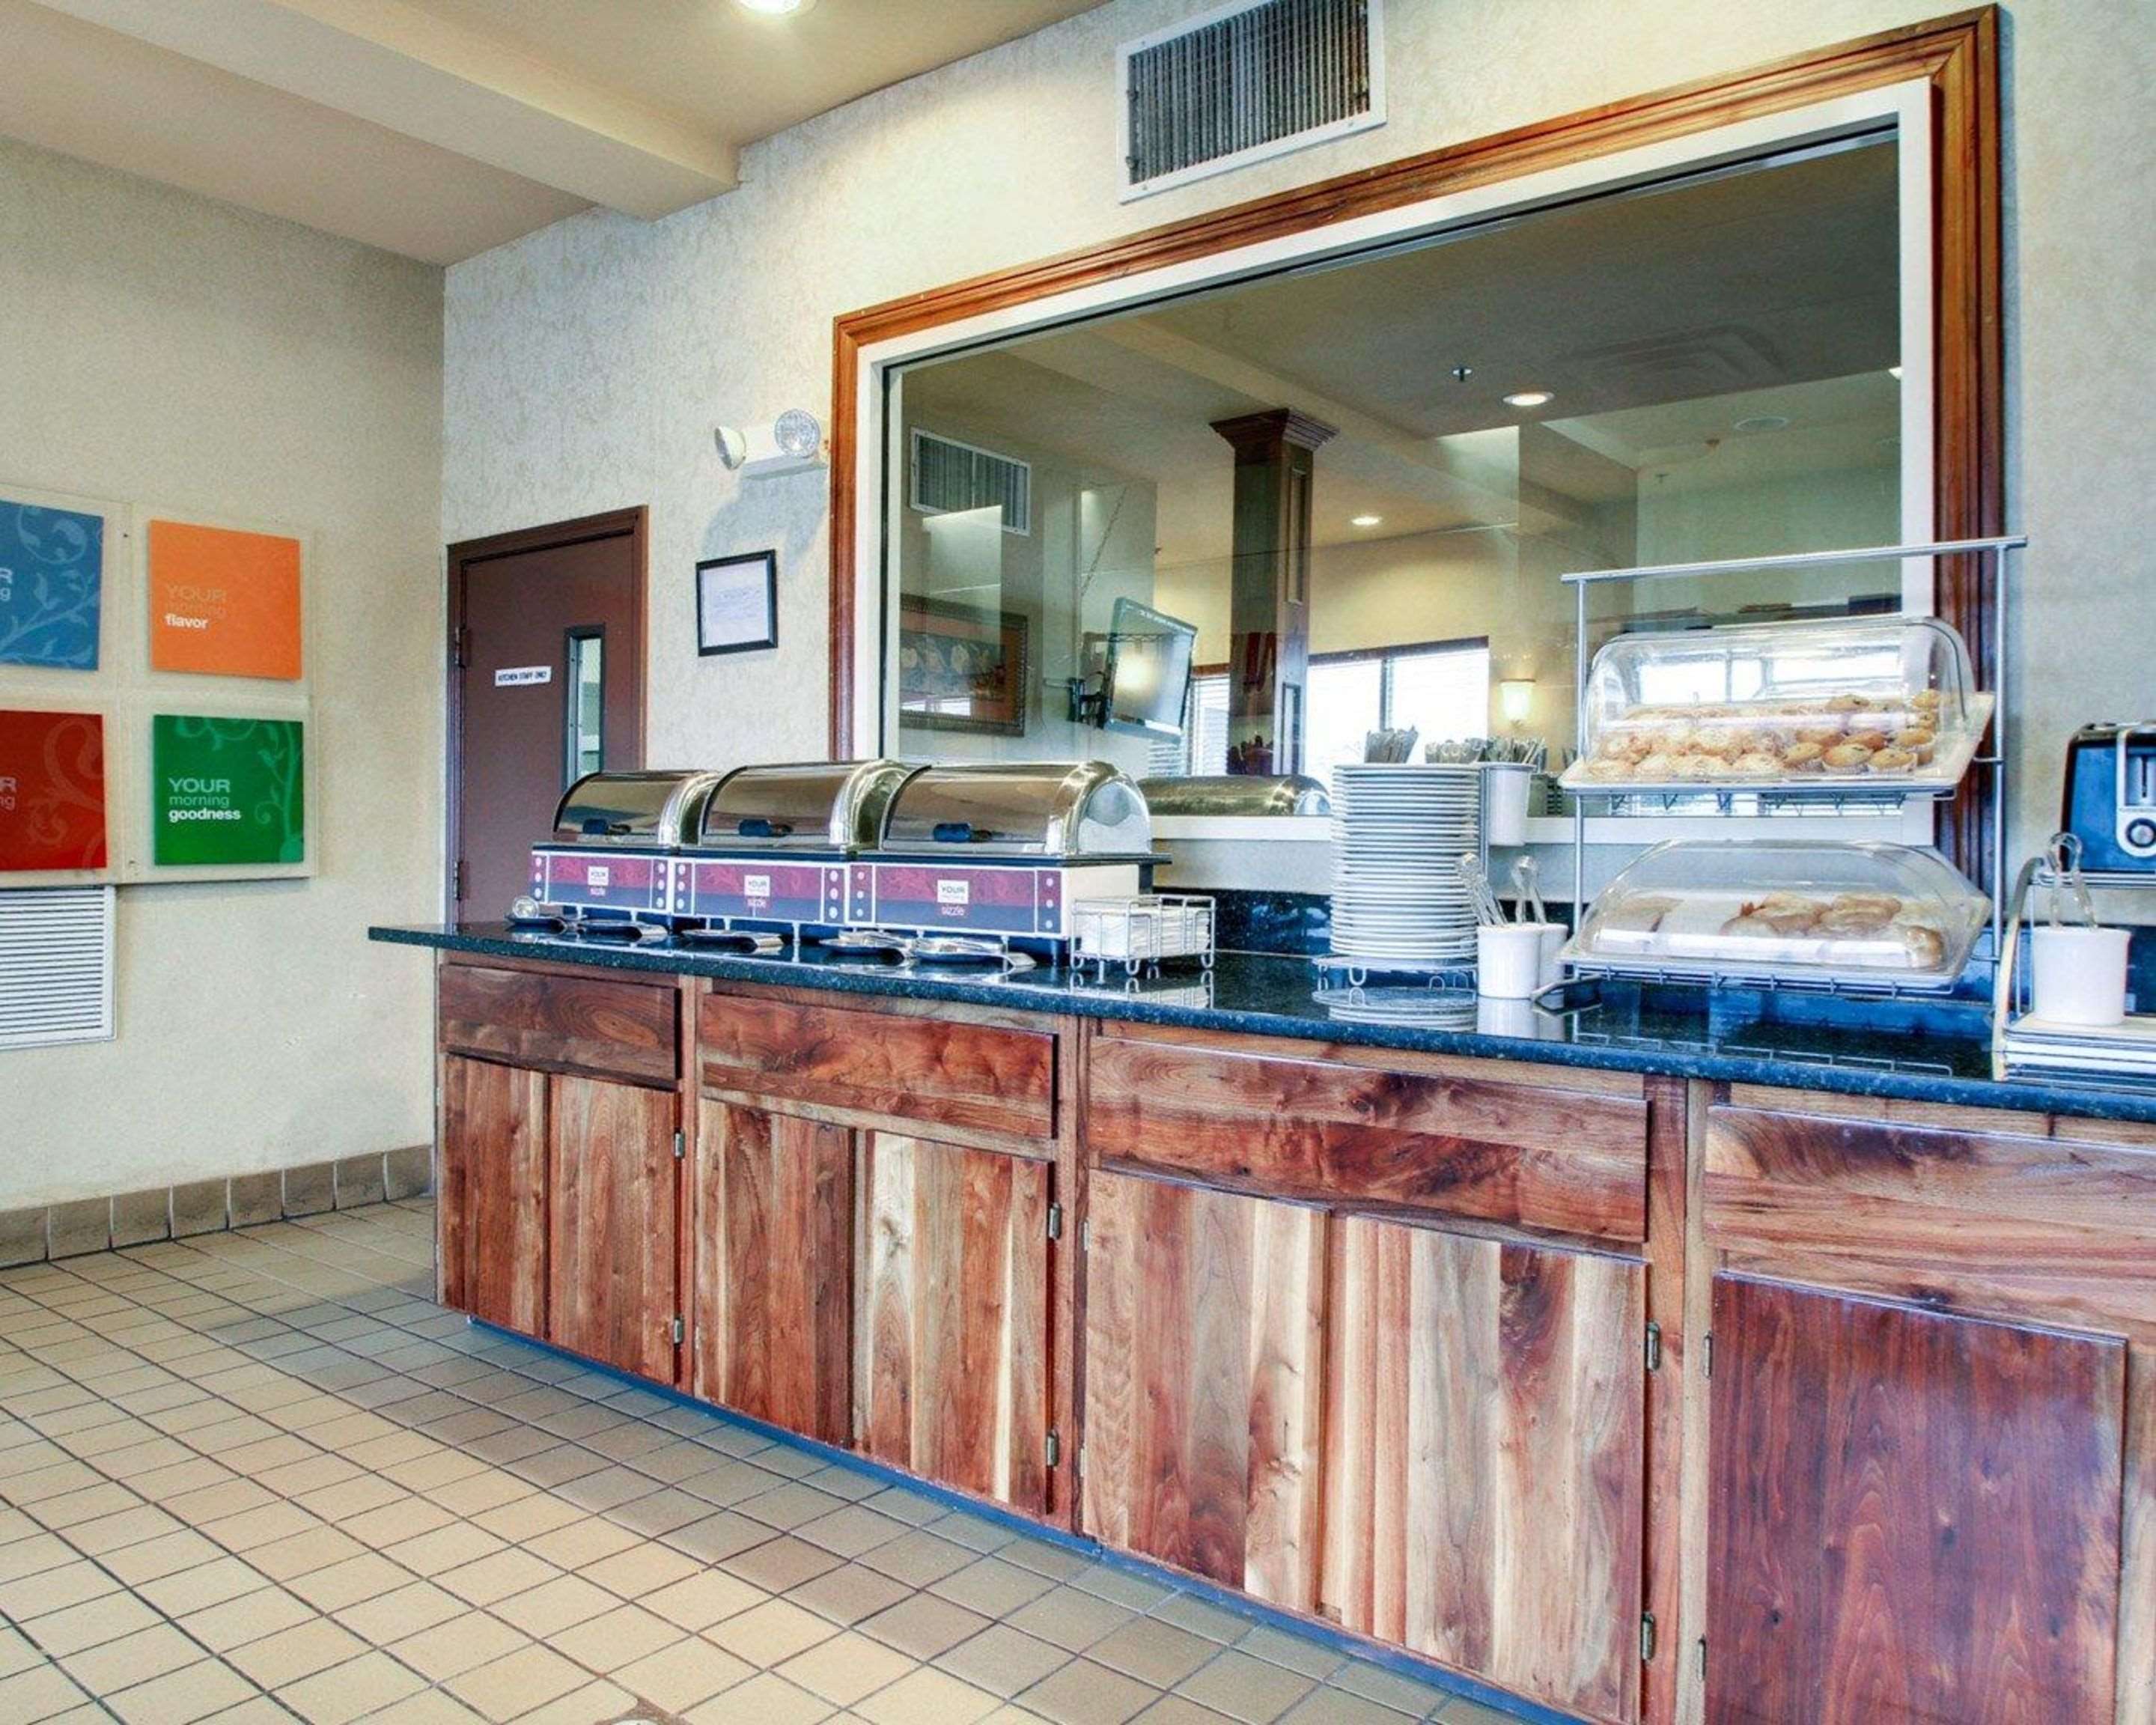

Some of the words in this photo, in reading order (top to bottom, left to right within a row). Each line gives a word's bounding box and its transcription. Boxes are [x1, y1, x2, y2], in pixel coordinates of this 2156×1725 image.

[164, 612, 209, 629] flavor
[168, 777, 231, 793] YOUR
[168, 796, 230, 809] morning
[168, 807, 241, 823] goodness
[940, 885, 966, 894] YOUR
